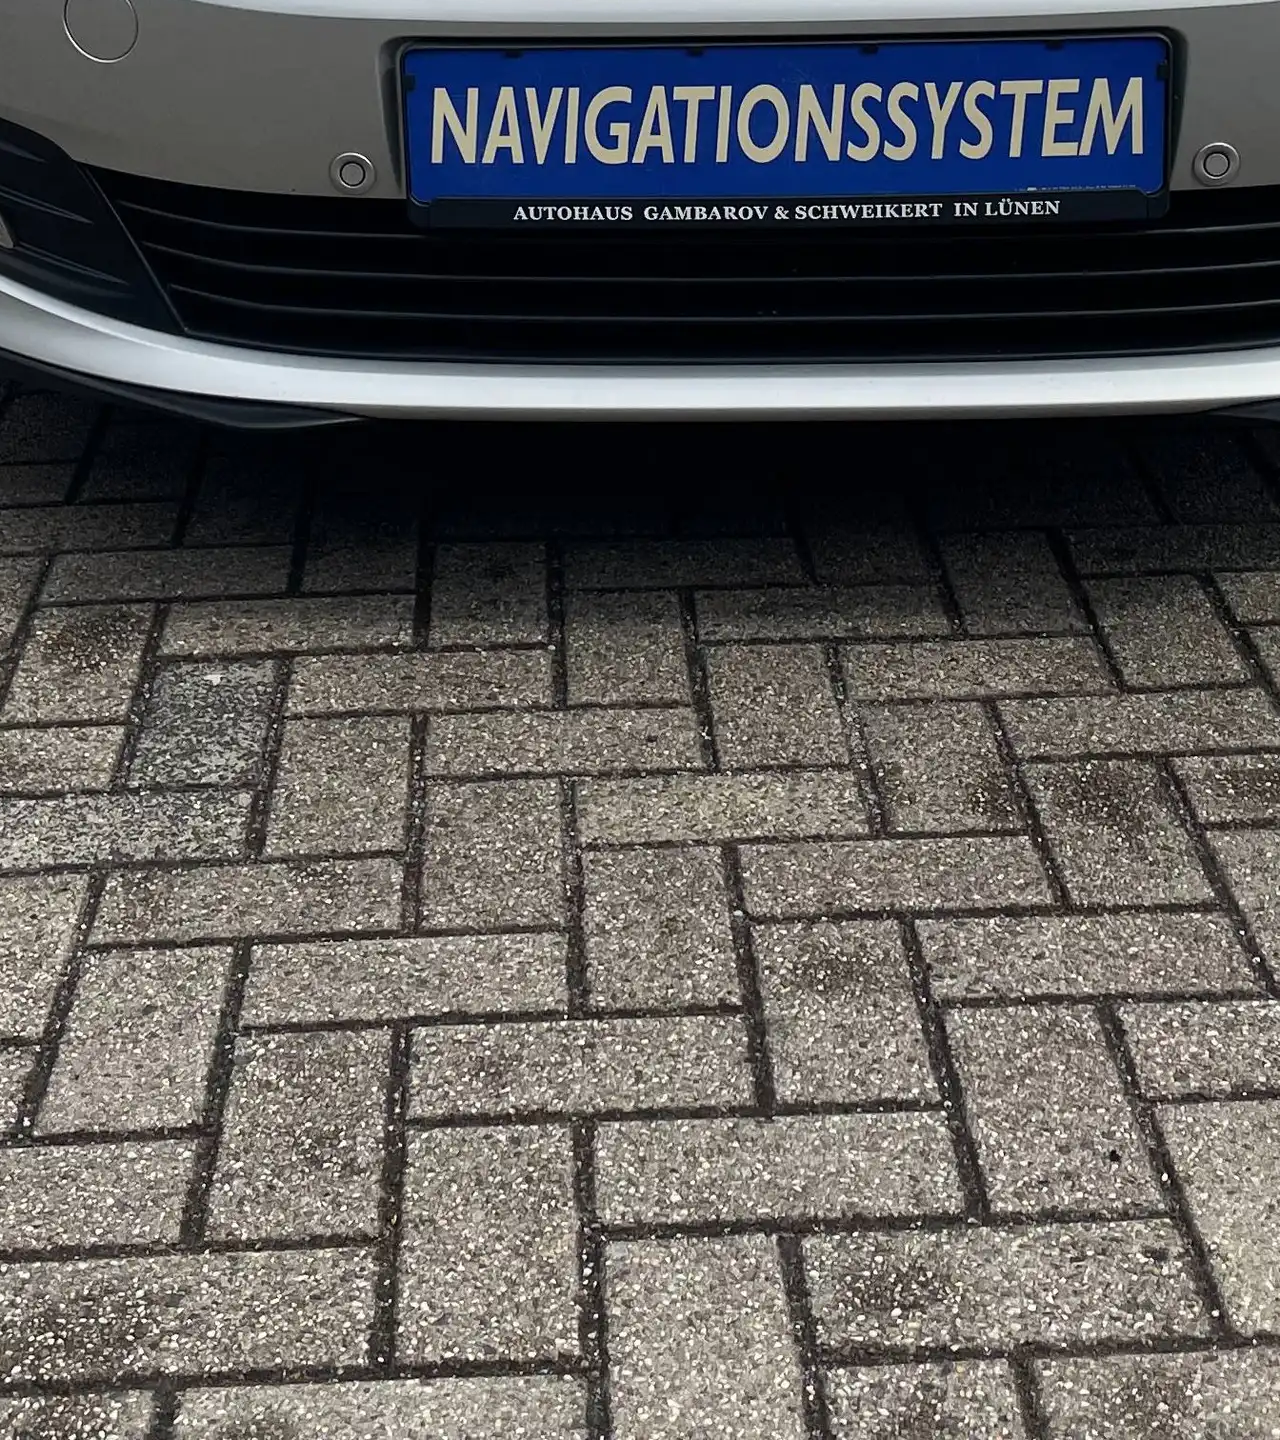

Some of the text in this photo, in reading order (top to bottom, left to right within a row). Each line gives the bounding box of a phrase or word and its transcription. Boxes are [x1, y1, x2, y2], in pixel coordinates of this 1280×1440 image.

[431, 76, 1144, 165] NAVIGATIONSSYSTEM
[513, 197, 1061, 221] AUTOHAUS GAMBAROV & SCHWEIKERT IN LÜNEN
